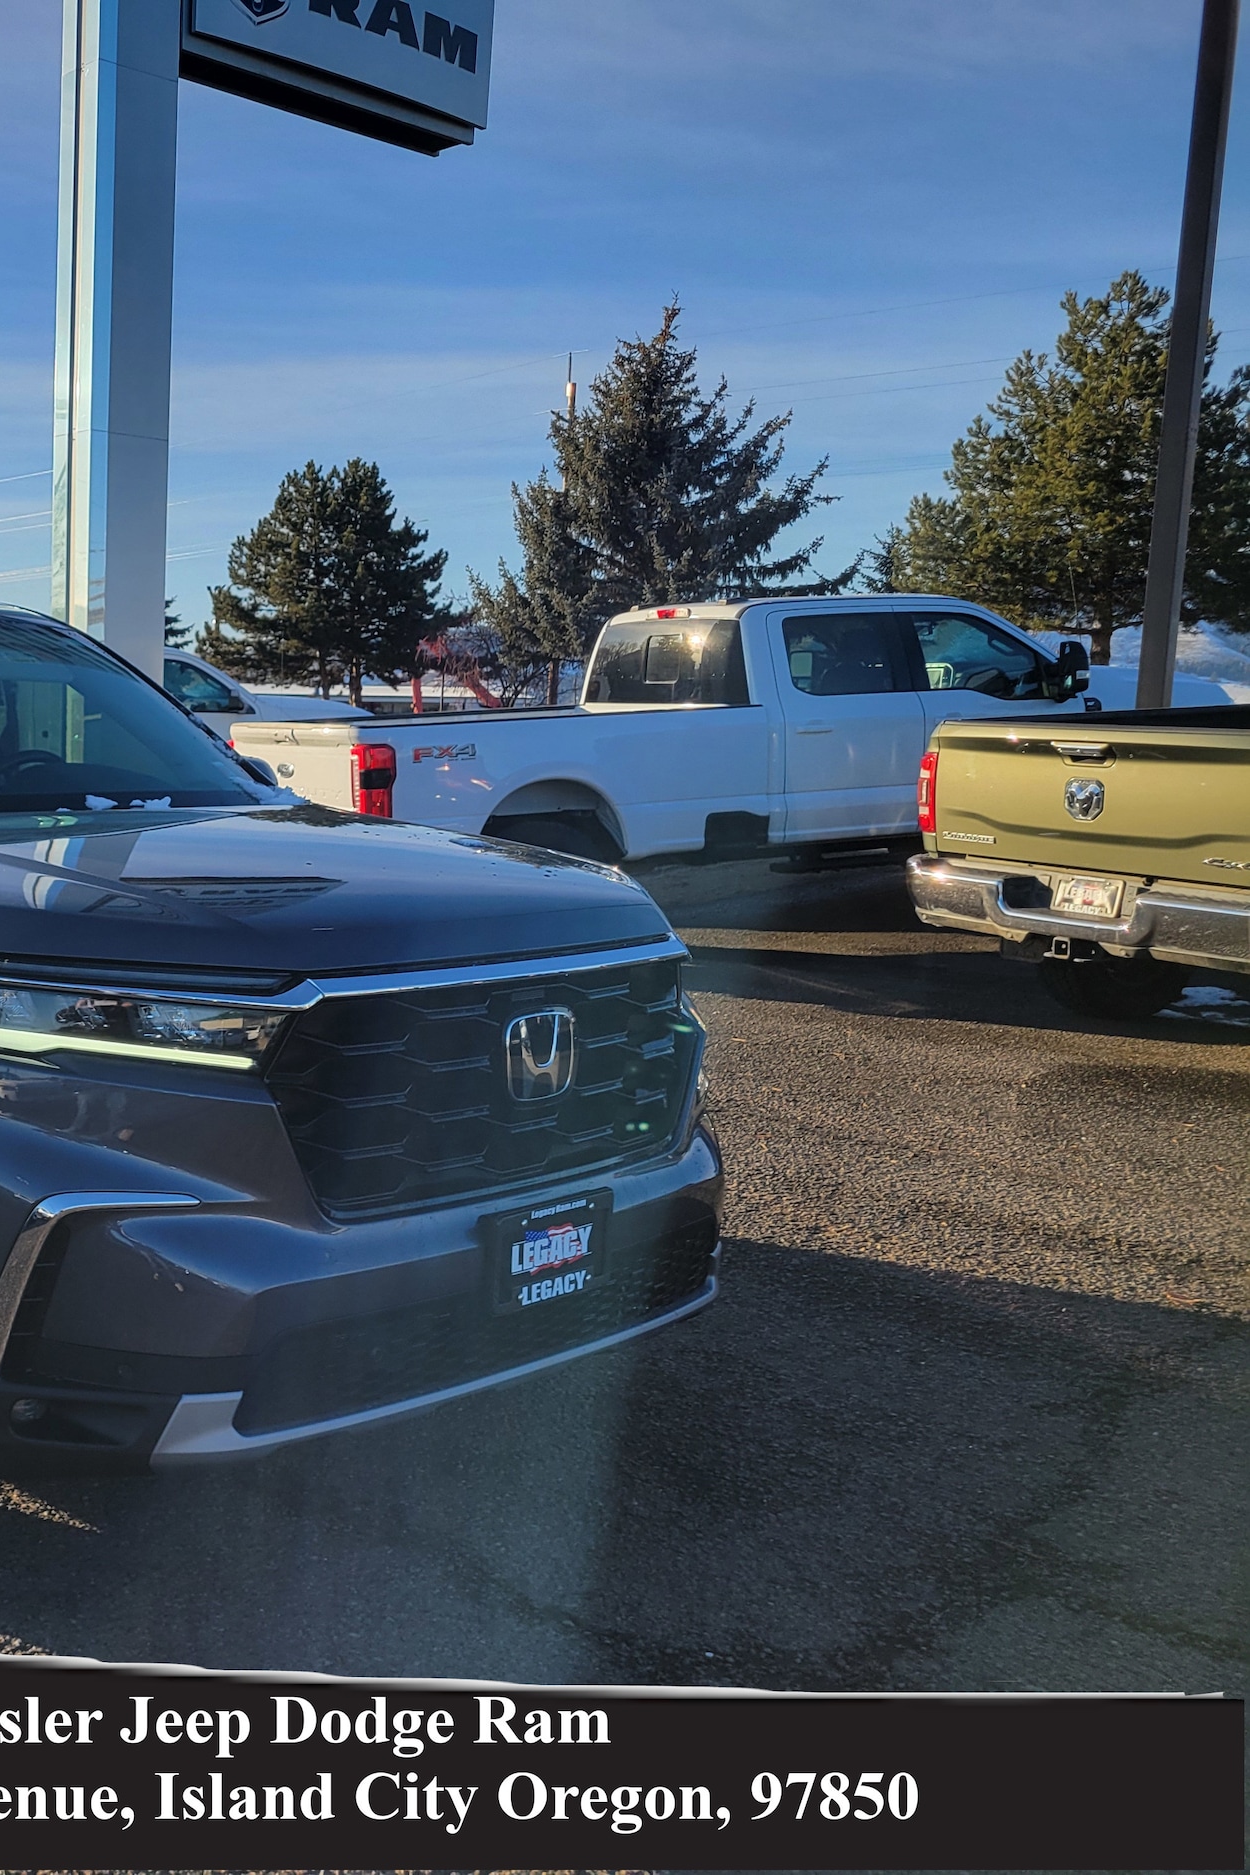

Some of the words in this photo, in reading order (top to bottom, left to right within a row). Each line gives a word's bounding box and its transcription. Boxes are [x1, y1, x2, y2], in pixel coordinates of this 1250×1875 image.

[413, 743, 477, 764] FX4
[1063, 903, 1102, 915] LEGACY
[511, 1225, 592, 1274] LEGACY
[521, 1270, 587, 1306] LEGACY
